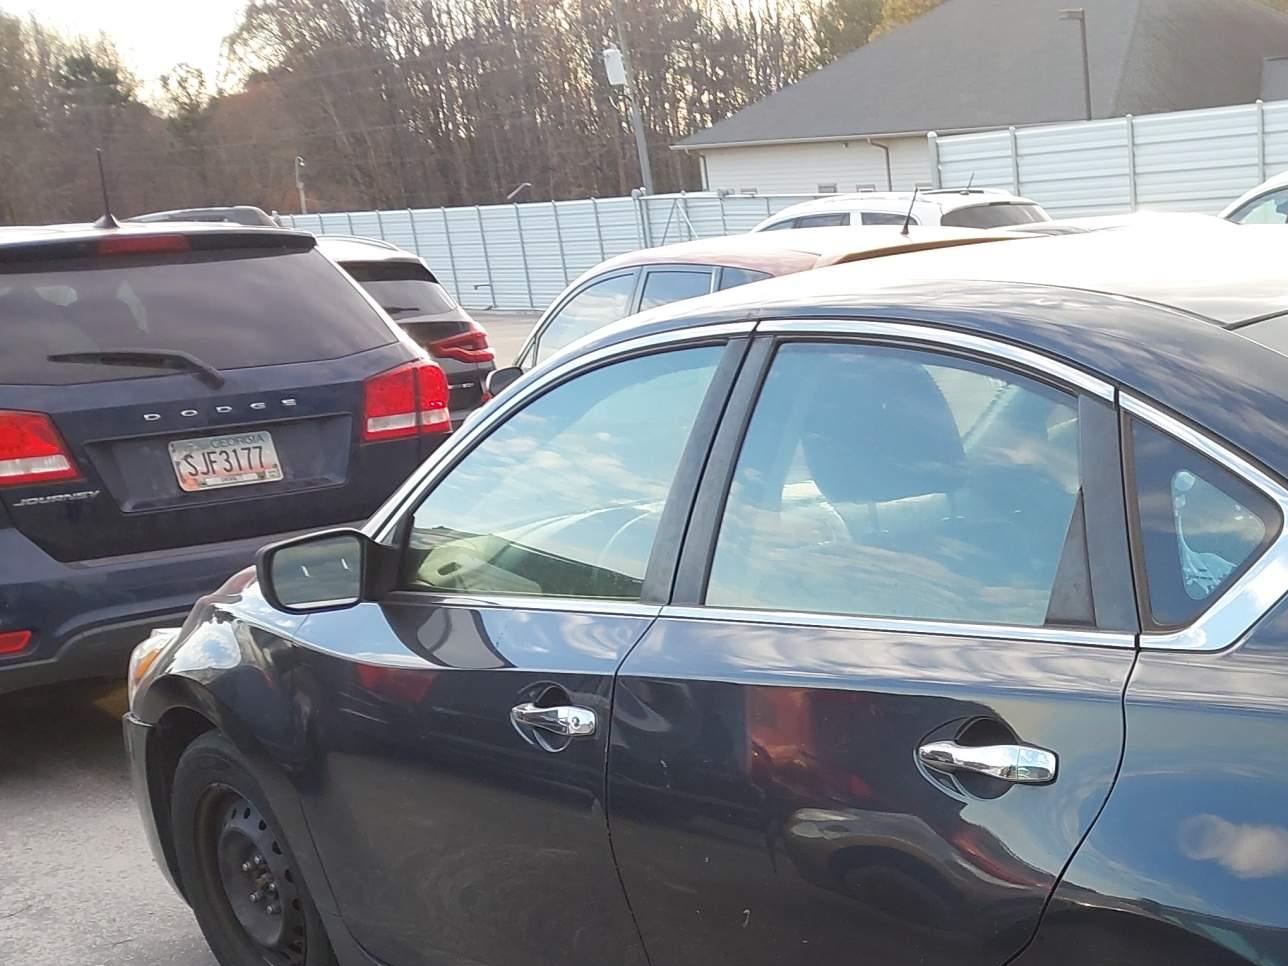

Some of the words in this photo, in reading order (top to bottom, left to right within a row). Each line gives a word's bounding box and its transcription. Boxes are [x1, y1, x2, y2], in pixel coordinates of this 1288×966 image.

[143, 398, 297, 421] DODGE
[183, 445, 265, 477] SJF3177
[13, 490, 100, 507] JOURNEY
